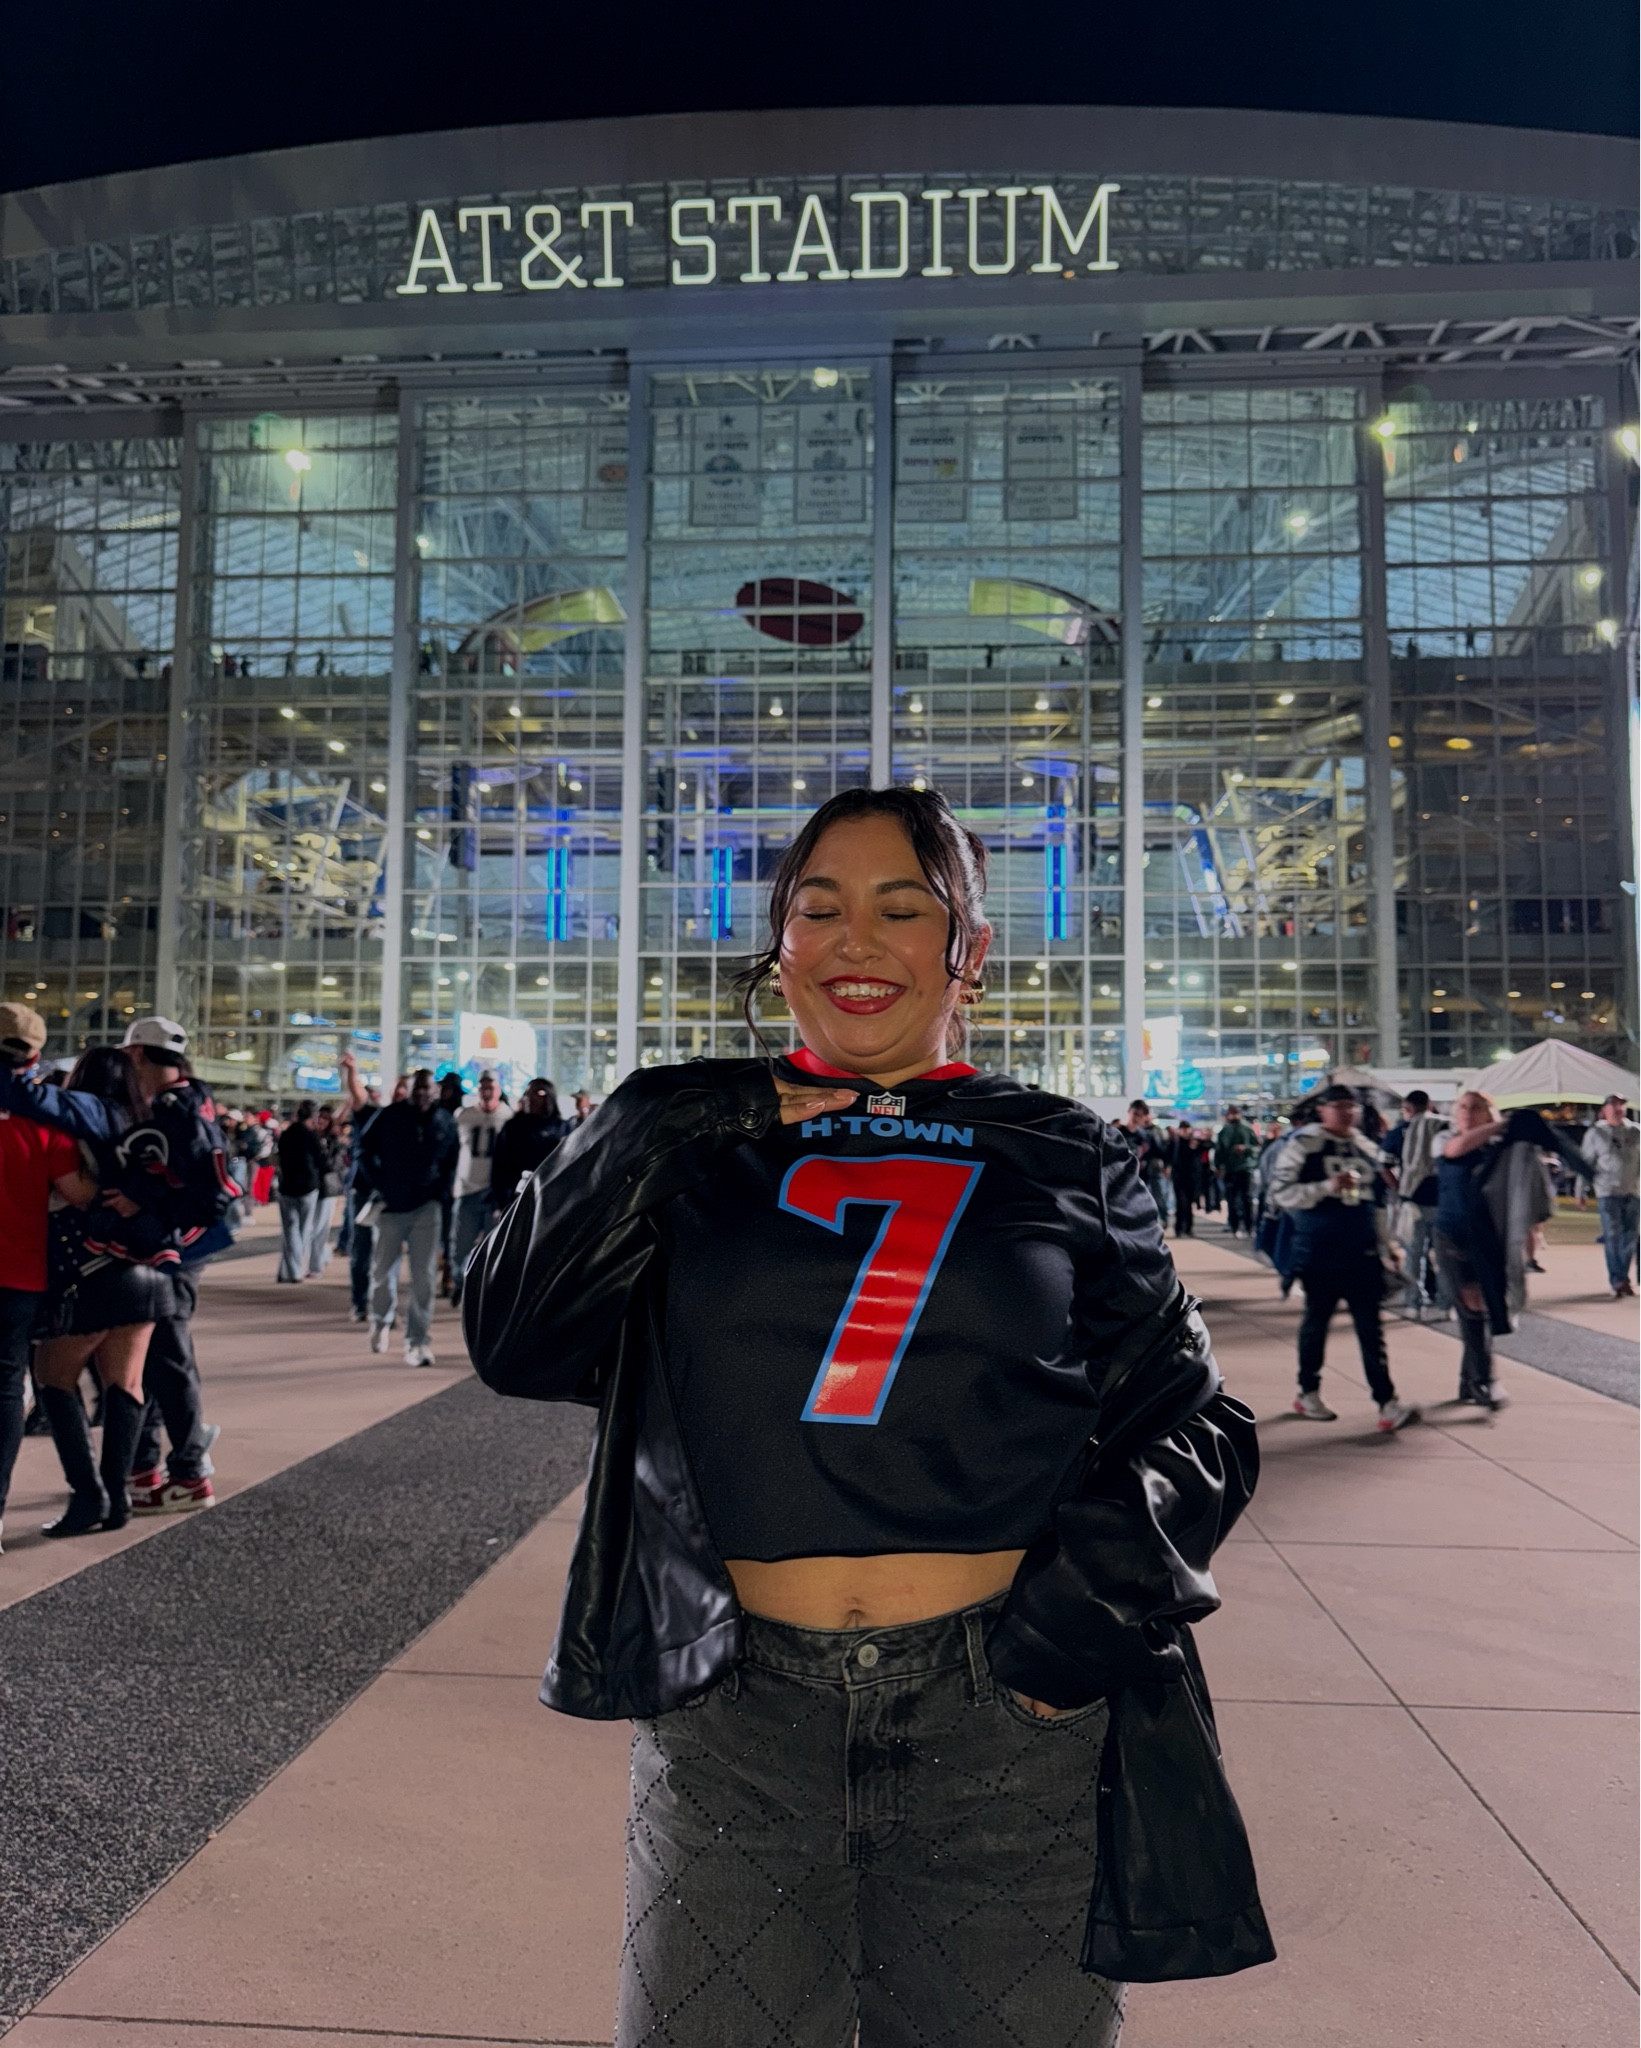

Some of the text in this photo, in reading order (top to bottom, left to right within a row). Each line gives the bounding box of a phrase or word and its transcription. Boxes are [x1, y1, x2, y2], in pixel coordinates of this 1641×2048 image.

[396, 183, 1121, 294] AT&T STADIUM
[776, 1154, 985, 1426] 7
